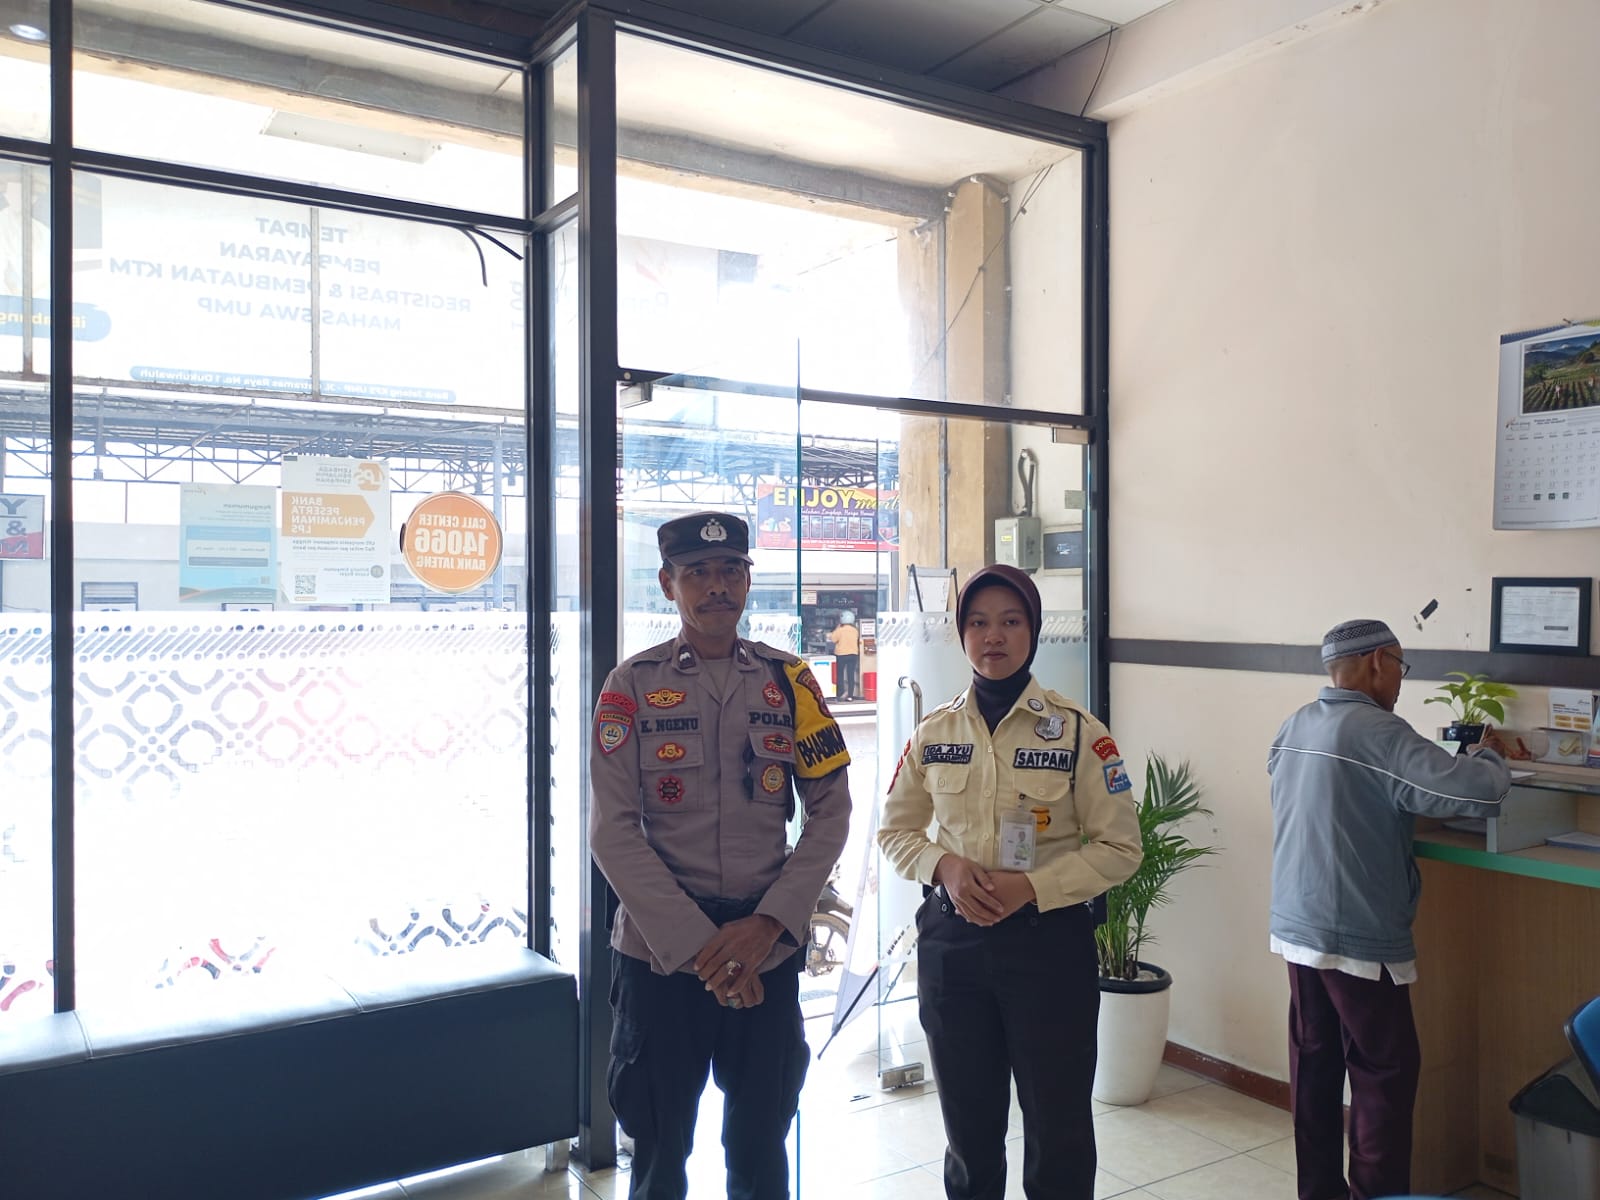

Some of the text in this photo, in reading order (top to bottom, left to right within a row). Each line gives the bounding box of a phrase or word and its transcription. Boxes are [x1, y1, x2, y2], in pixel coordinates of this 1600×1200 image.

[773, 486, 855, 509] ENJOY
[749, 711, 793, 727] POLR
[947, 745, 970, 755] AYU
[1016, 751, 1071, 770] SATPAM
